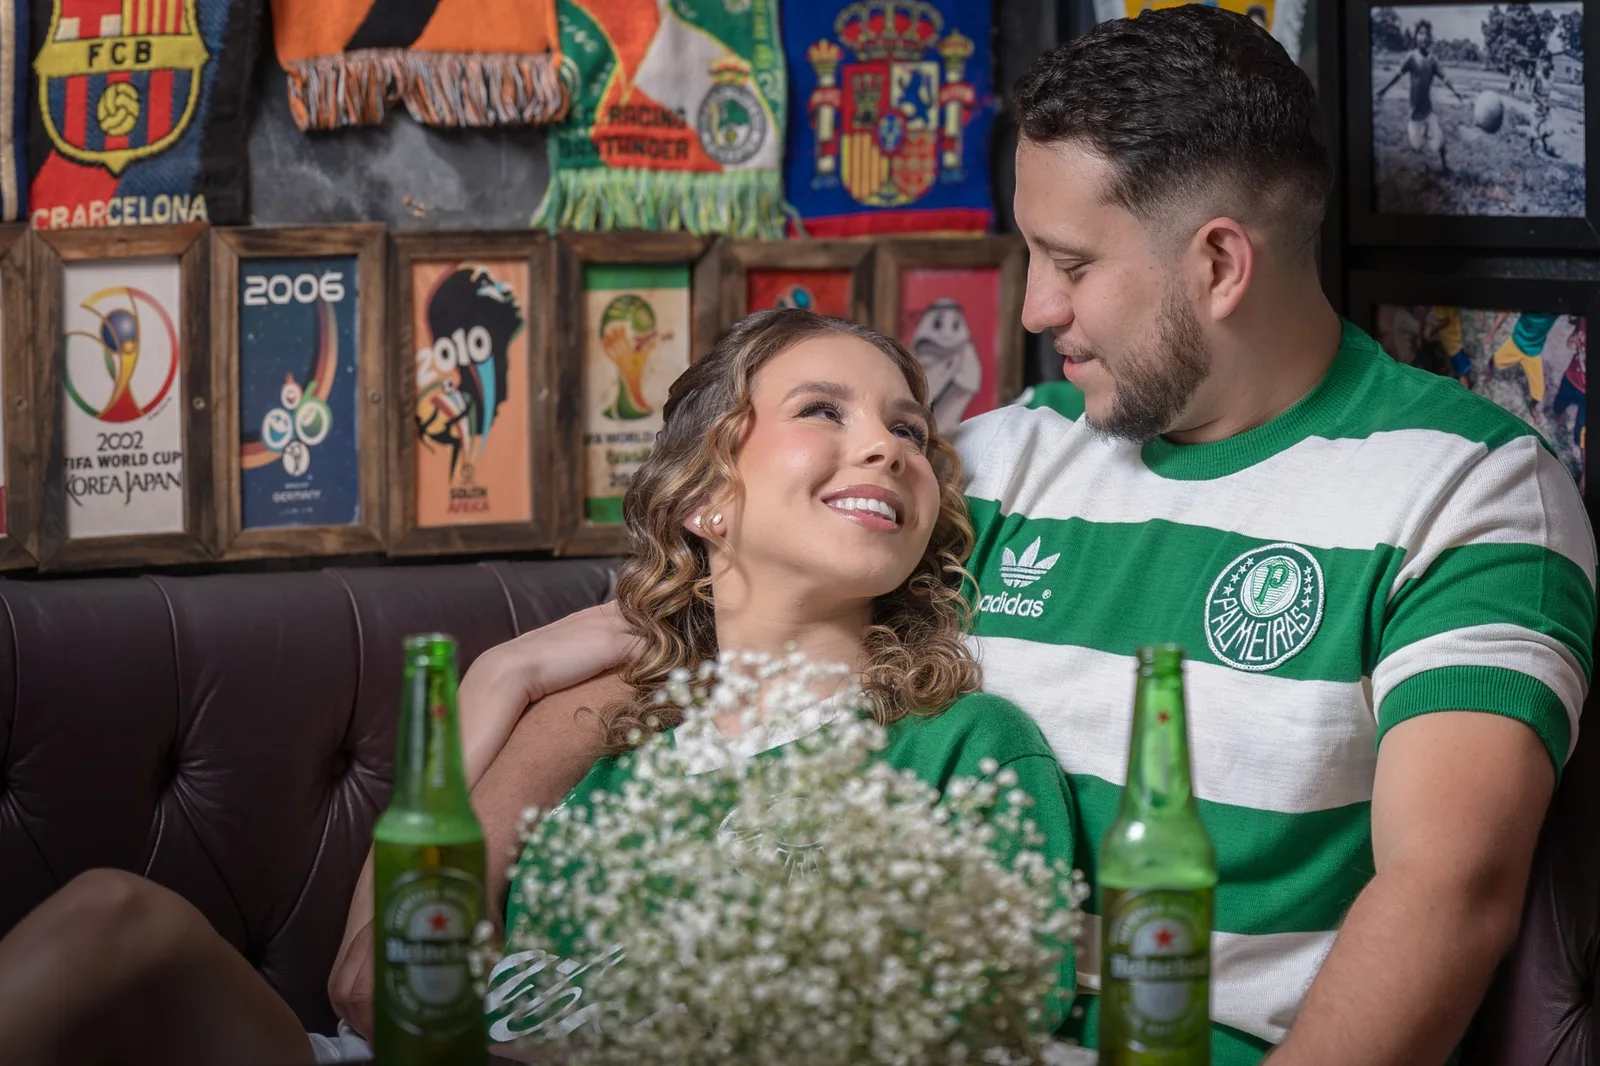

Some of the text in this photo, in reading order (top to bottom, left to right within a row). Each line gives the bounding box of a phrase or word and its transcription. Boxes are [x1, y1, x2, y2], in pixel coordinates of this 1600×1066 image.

[88, 41, 153, 68] FCB
[244, 272, 345, 305] 2006
[415, 325, 492, 387] 2010
[96, 430, 144, 452] 2002
[97, 452, 149, 468] WORLD
[153, 450, 182, 466] CUP
[979, 590, 1045, 617] adidas
[1210, 597, 1311, 661] PALMEIRAS
